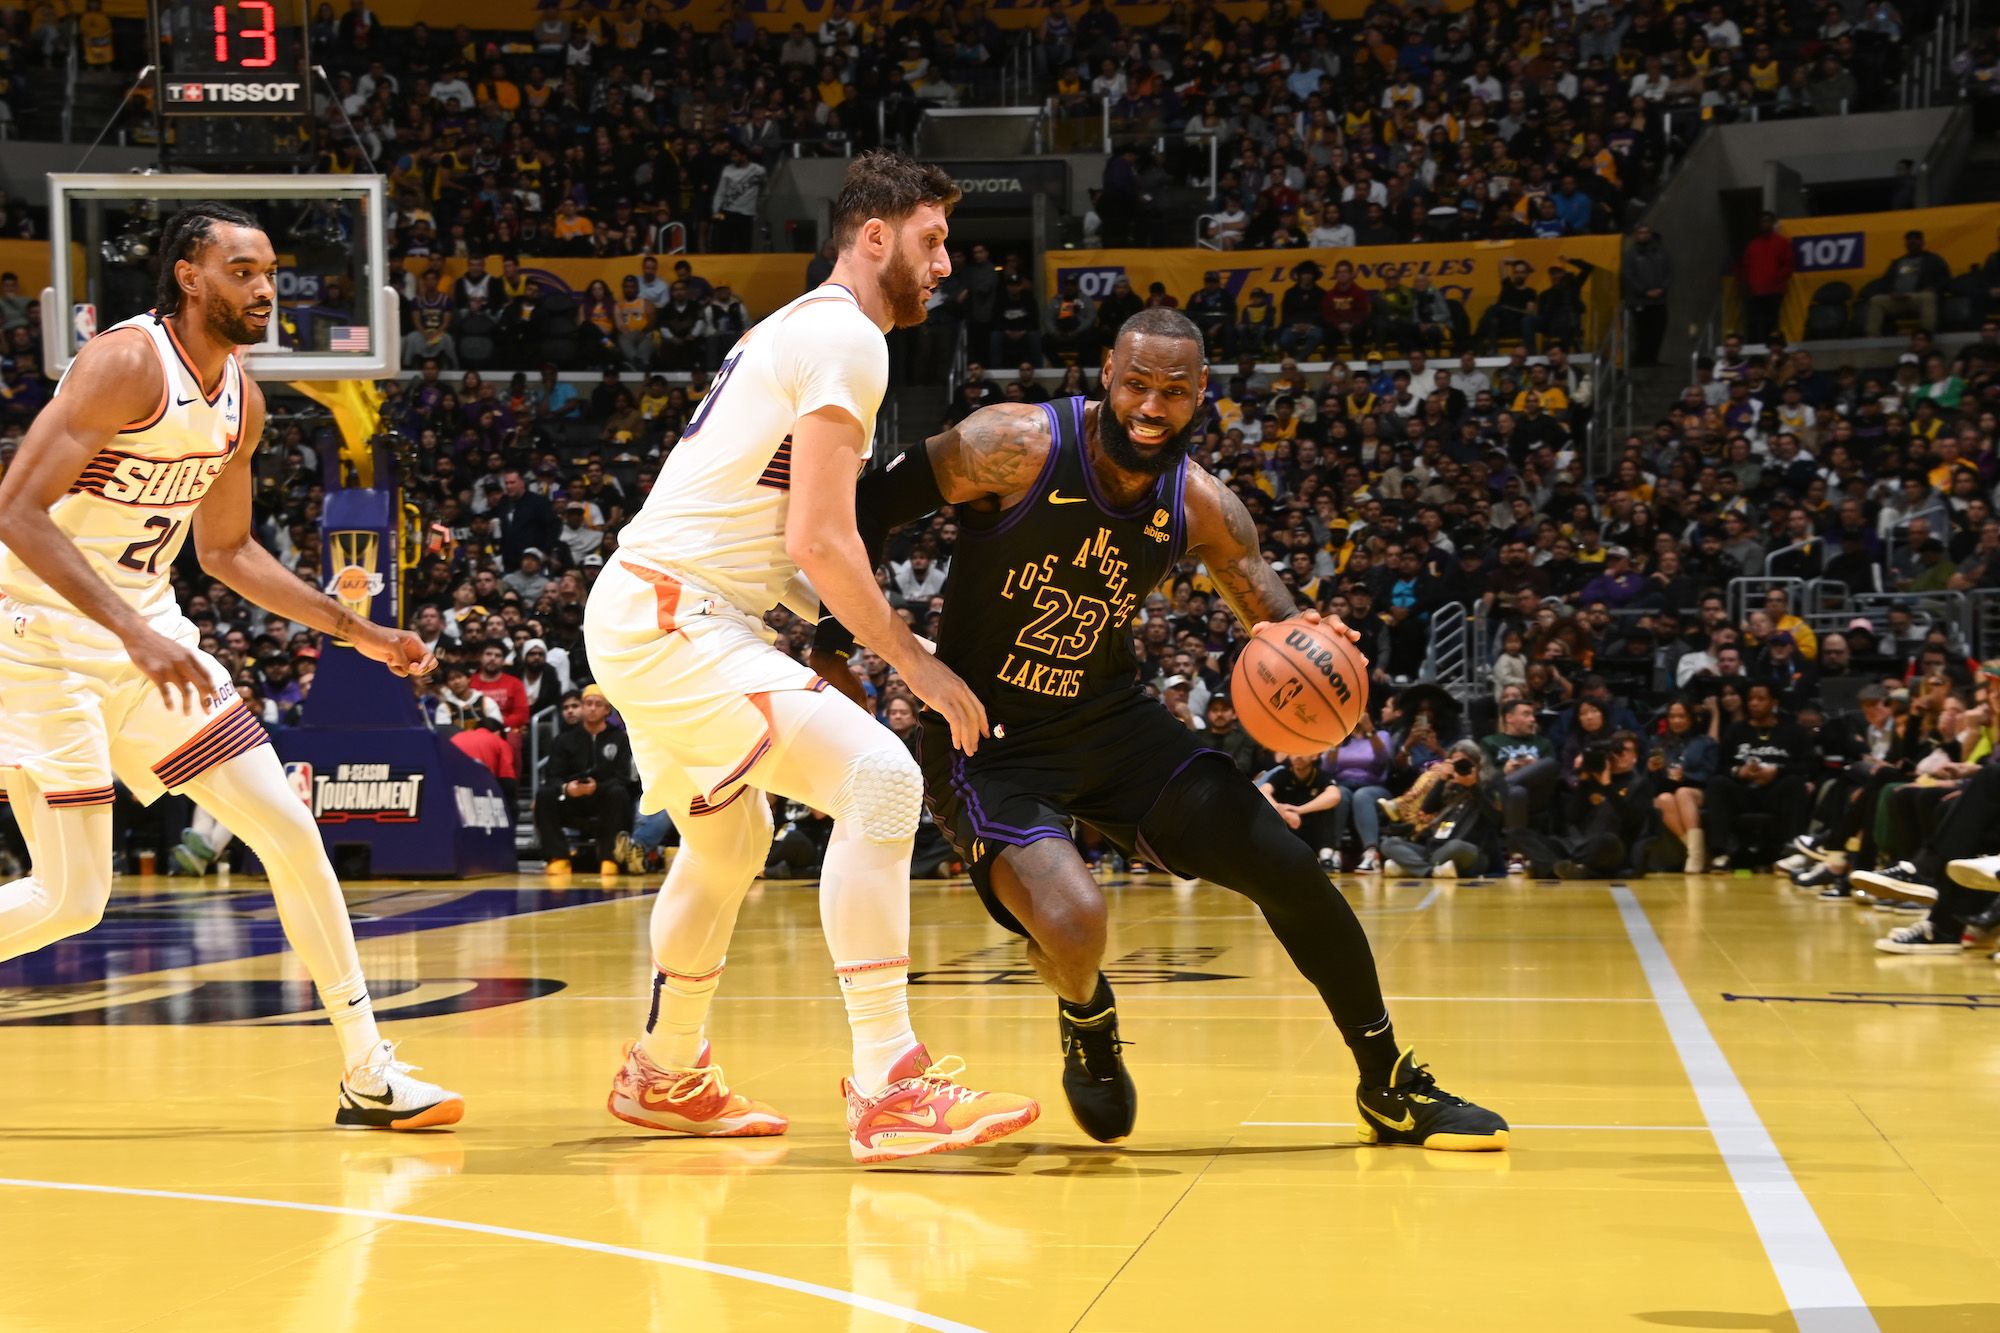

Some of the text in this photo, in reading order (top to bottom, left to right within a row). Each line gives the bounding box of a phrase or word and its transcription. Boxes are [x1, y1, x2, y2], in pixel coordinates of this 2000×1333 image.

[213, 1, 276, 67] 13
[204, 83, 299, 102] TISSOT
[1330, 258, 1475, 281] NGELES
[1800, 238, 1856, 266] 107
[277, 271, 320, 296] 06
[1079, 271, 1117, 297] 07
[103, 457, 224, 505] SUNS
[117, 514, 182, 575] 21
[1143, 524, 1170, 543] bibigo
[1001, 554, 1059, 600] LOS
[1072, 527, 1136, 629] ANGELES
[1015, 585, 1110, 661] 23
[997, 653, 1085, 698] LAKERS
[337, 764, 390, 781] IN-SEASON
[314, 774, 424, 818] TOURNAMENT
